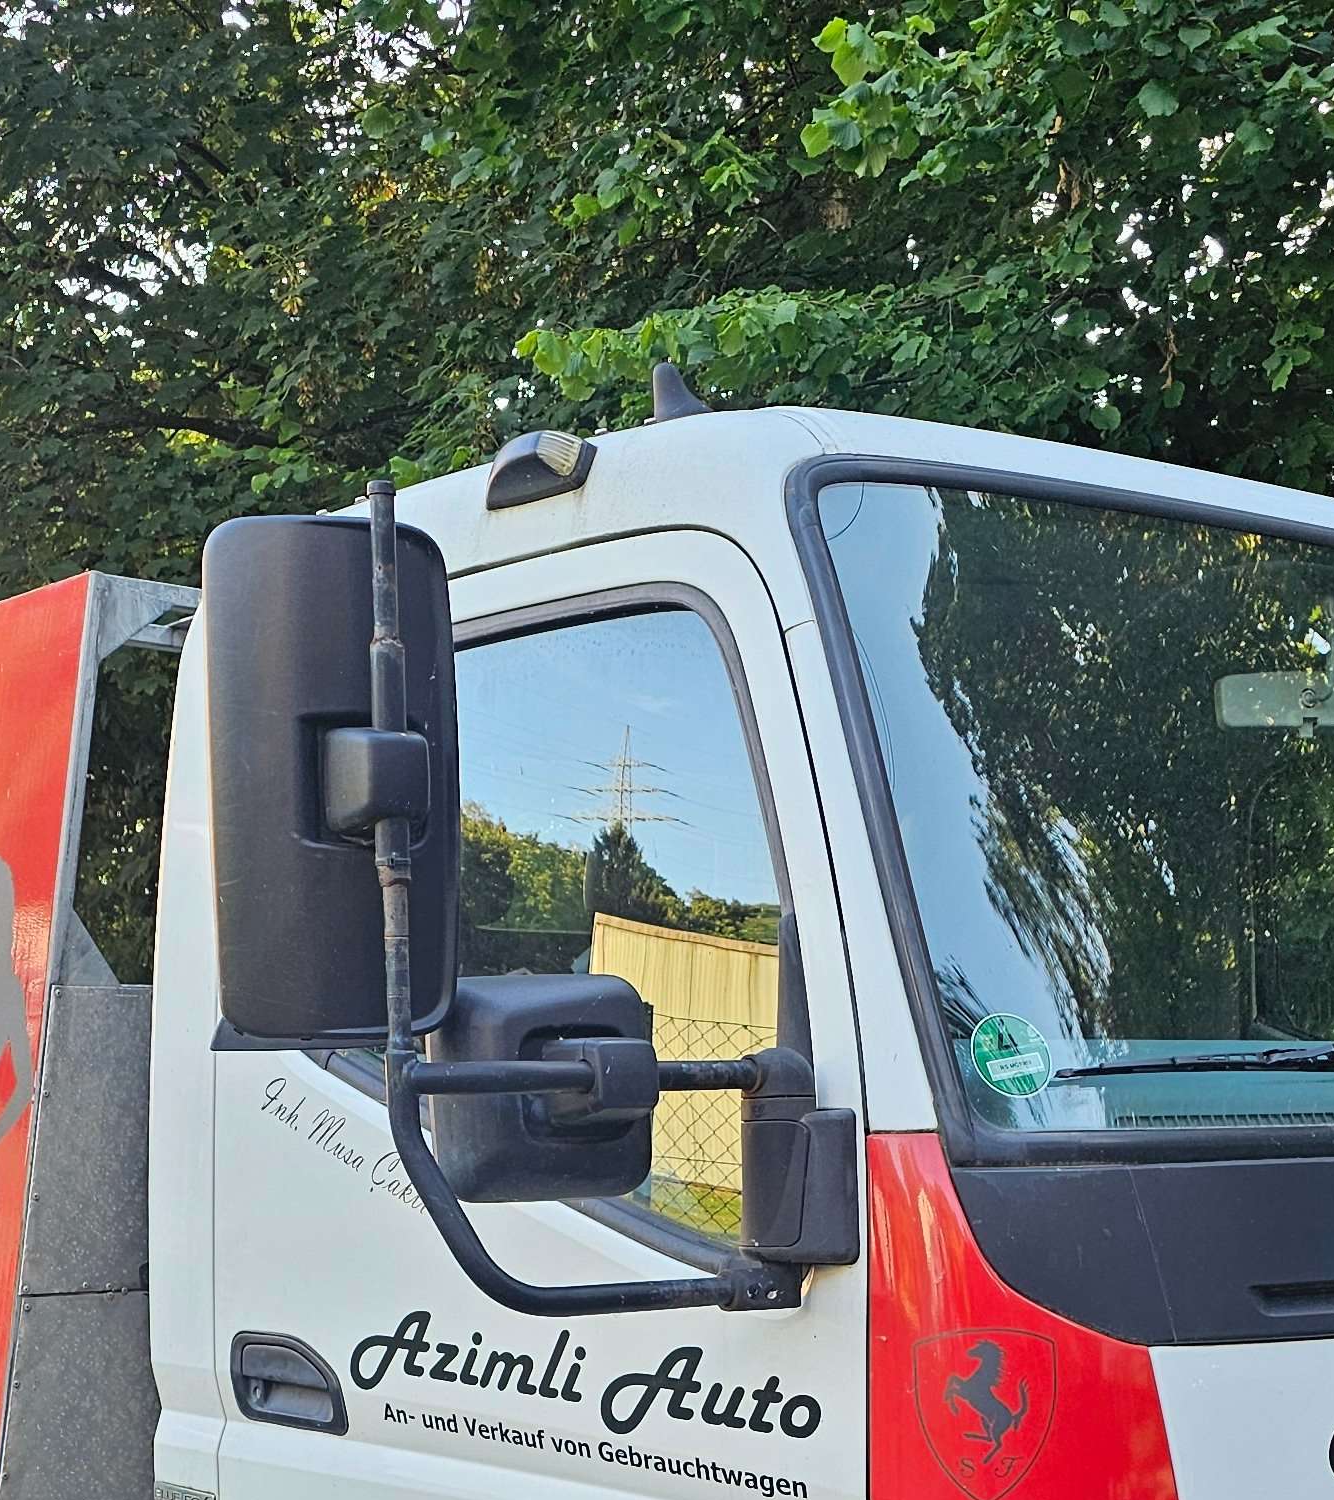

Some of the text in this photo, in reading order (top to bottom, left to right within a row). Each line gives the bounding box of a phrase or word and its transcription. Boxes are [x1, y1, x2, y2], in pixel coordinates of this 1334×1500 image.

[261, 1078, 307, 1131] Inh.
[308, 1109, 365, 1172] Musa
[350, 1310, 822, 1439] Azimli Auto
[383, 1403, 808, 1499] An- und Verkauf von Gebrauchtwagen
